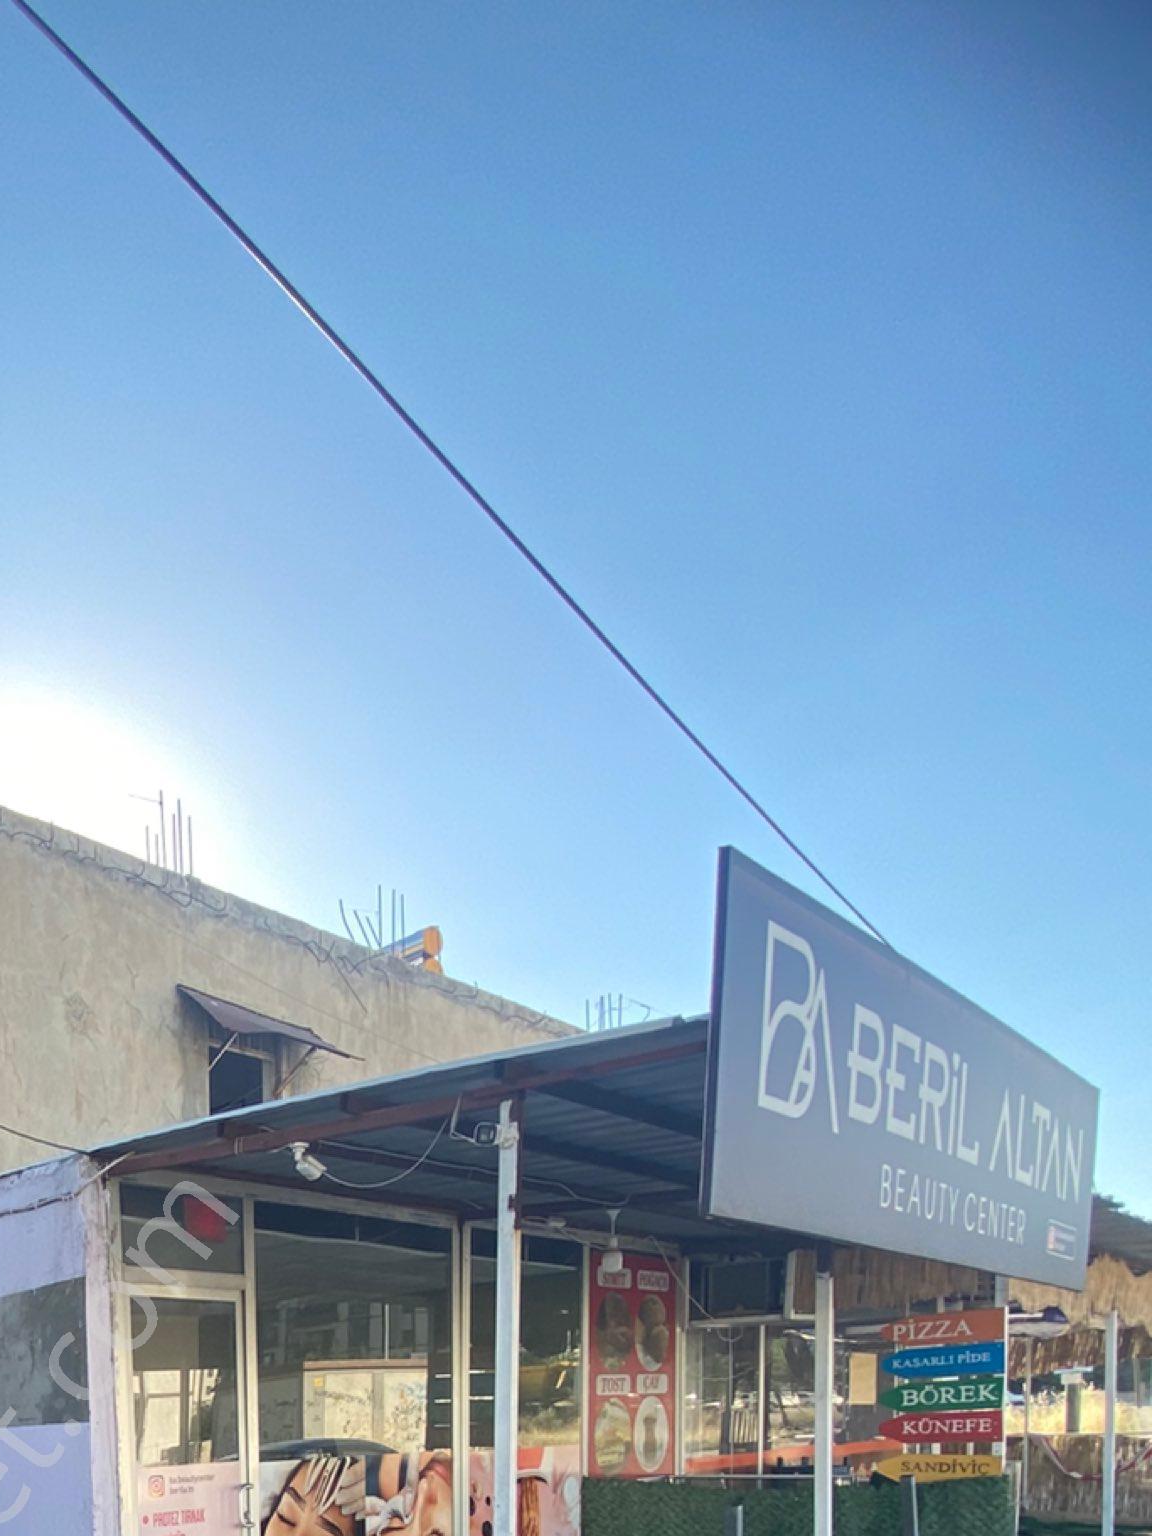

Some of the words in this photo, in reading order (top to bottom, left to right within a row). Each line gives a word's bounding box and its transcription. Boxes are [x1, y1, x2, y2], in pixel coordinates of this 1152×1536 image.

[989, 1087, 1084, 1204] ALTAN
[880, 1163, 959, 1226] BEAUTY
[963, 1192, 1027, 1246] CENTER
[893, 1319, 973, 1342] PİZZA
[957, 1350, 992, 1365] PİDE
[600, 1377, 626, 1393] TOST
[901, 1384, 999, 1407] BÖREK
[902, 1417, 993, 1435] KÜNEFE
[900, 1458, 991, 1477] SANDİVİÇ
